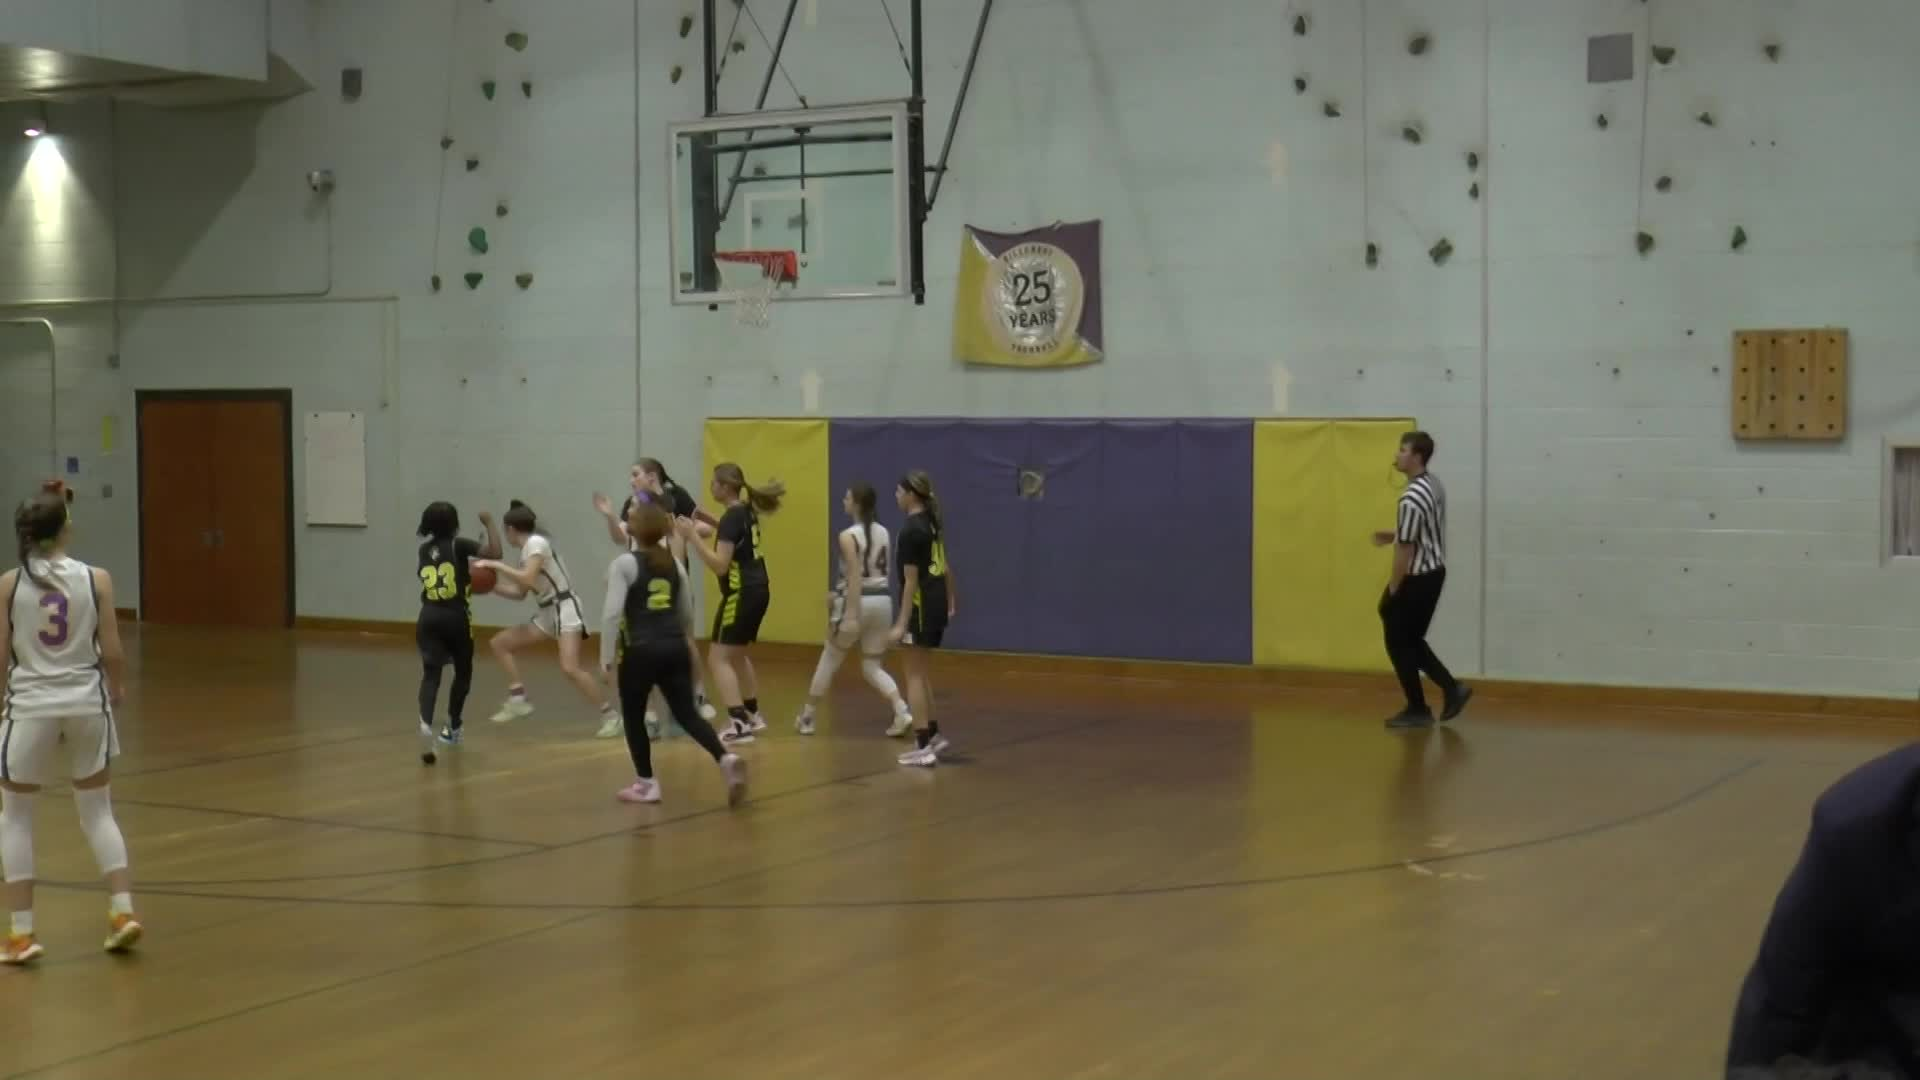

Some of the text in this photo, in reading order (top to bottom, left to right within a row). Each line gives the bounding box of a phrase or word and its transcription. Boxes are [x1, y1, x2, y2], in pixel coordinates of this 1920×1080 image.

[1013, 269, 1051, 306] 25
[1009, 309, 1056, 328] YEARS
[420, 561, 457, 600] 23
[647, 577, 671, 610] 2
[38, 591, 68, 646] 3
